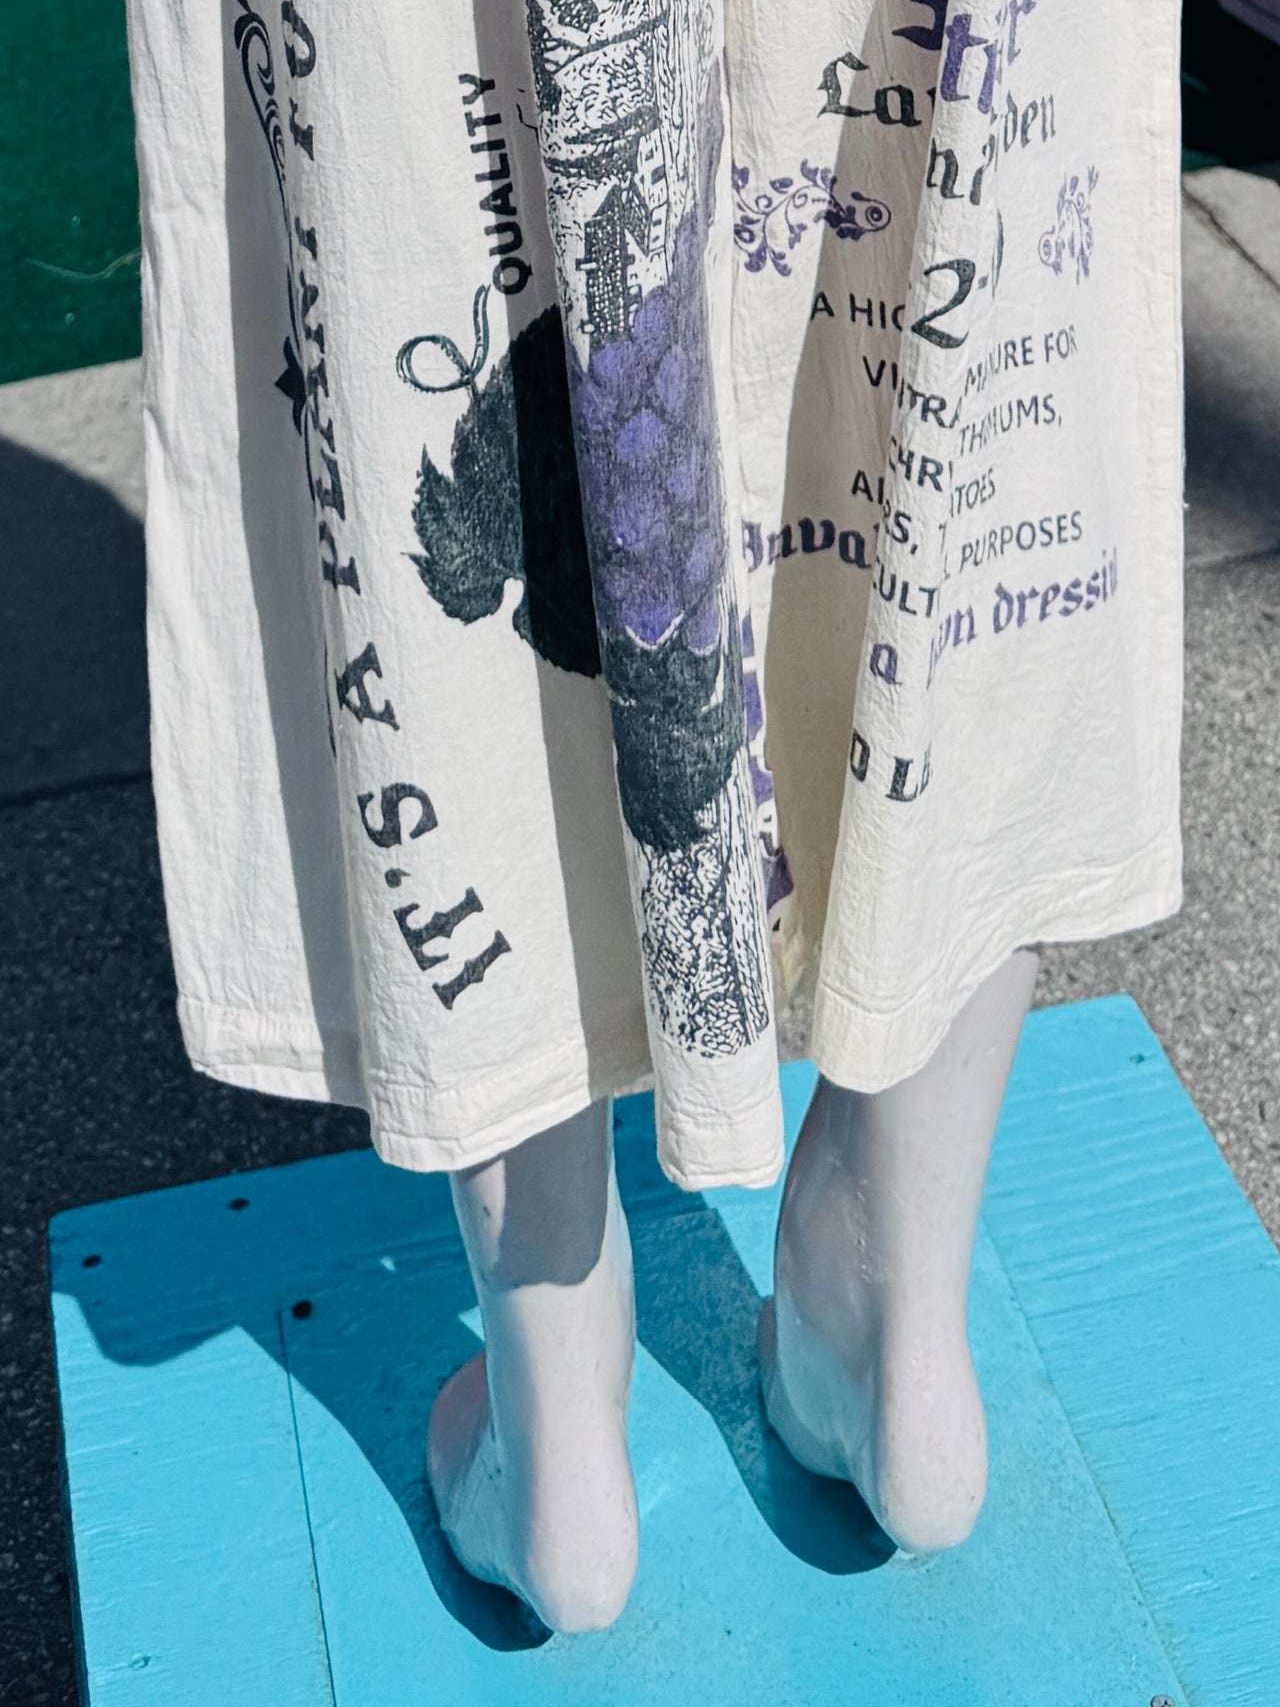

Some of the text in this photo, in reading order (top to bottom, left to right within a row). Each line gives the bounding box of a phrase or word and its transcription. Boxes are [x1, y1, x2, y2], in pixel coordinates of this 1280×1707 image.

[458, 72, 533, 296] QUALITY
[959, 510, 1083, 573] PURPOSES
[336, 641, 400, 731] A
[357, 781, 513, 1011] IT'S
